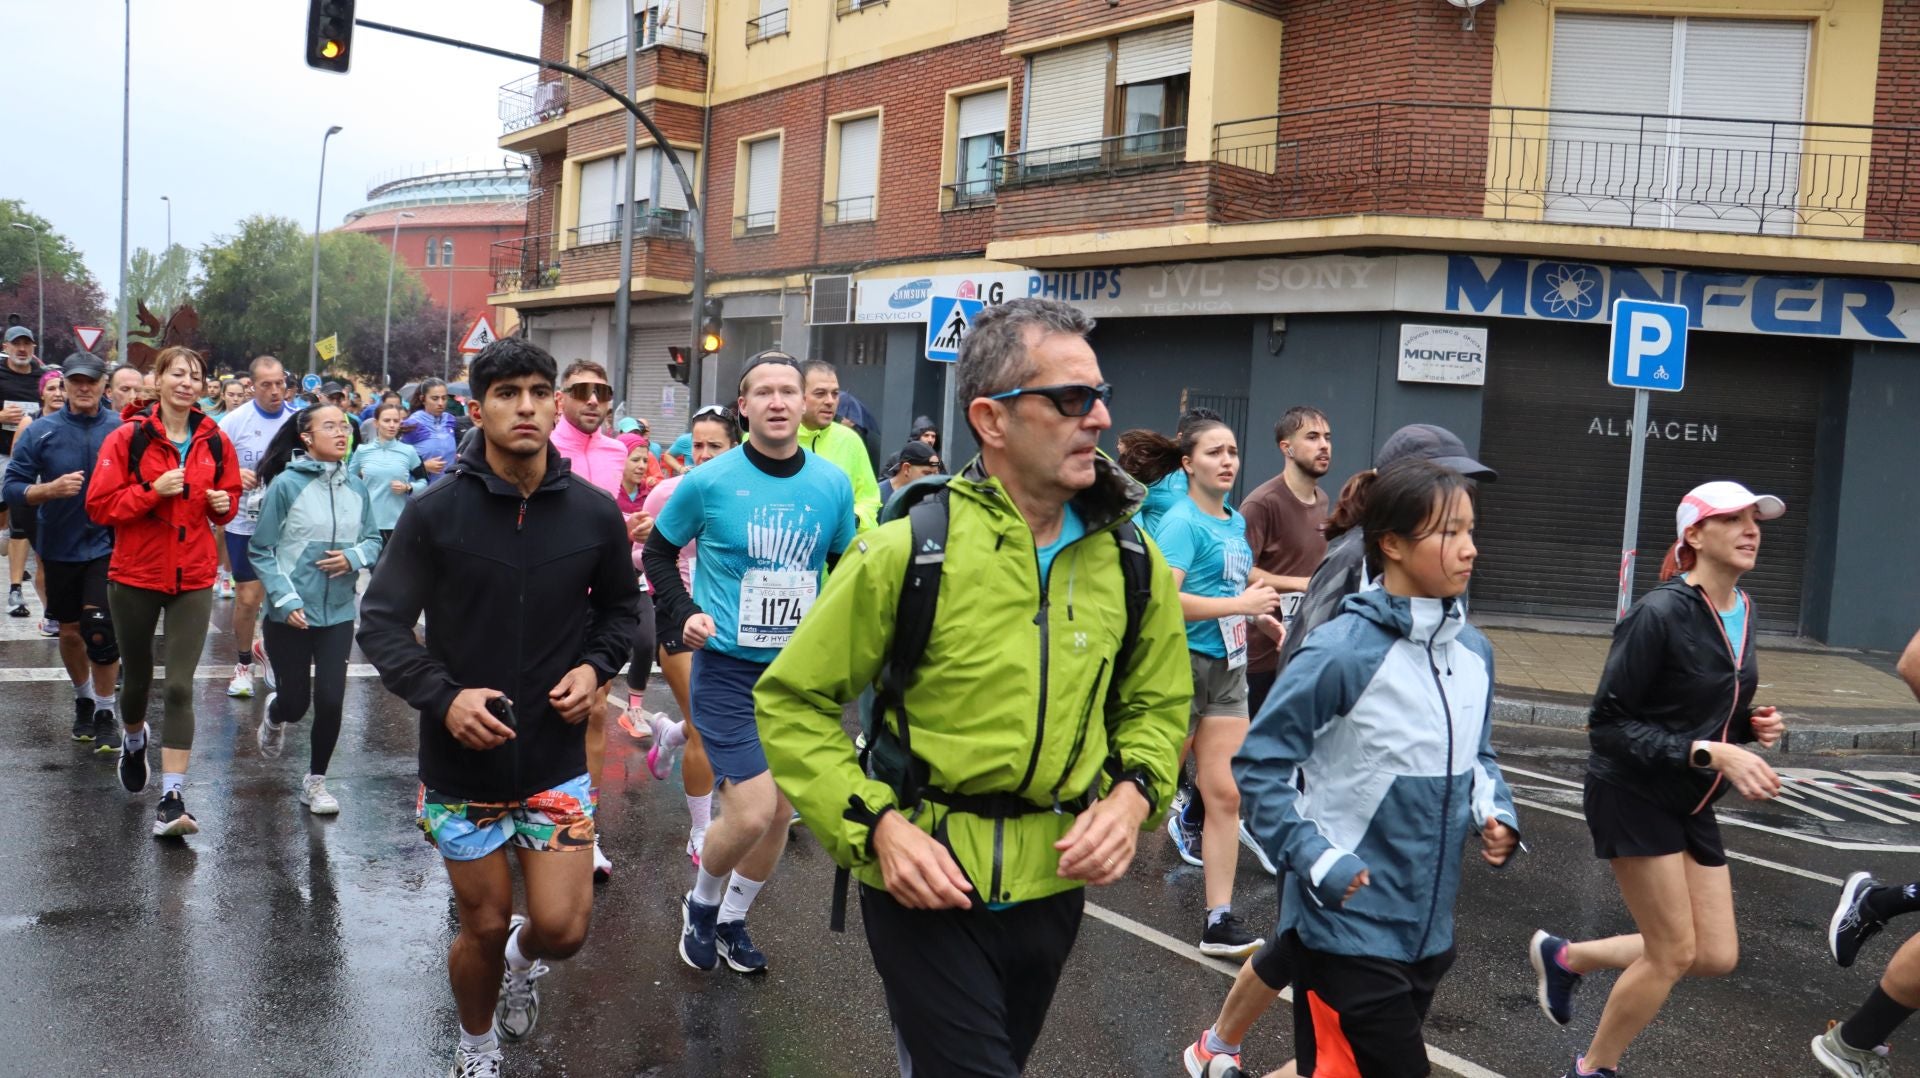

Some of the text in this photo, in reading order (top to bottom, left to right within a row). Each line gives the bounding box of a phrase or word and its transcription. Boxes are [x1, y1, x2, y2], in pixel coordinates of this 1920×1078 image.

[1028, 267, 1122, 301] PHILIPS
[1148, 266, 1226, 299] JVC
[1256, 262, 1377, 291] SONY
[977, 281, 1004, 306] LG
[1445, 255, 1907, 338] MONFER
[858, 311, 922, 321] SERVICIO
[1141, 300, 1234, 314] TECNICA
[1404, 349, 1483, 363] MONFER
[1626, 311, 1672, 377] P
[1588, 417, 1718, 442] ALMACEN
[244, 450, 263, 462] ar
[761, 597, 802, 625] 1174
[1290, 596, 1304, 615] 7
